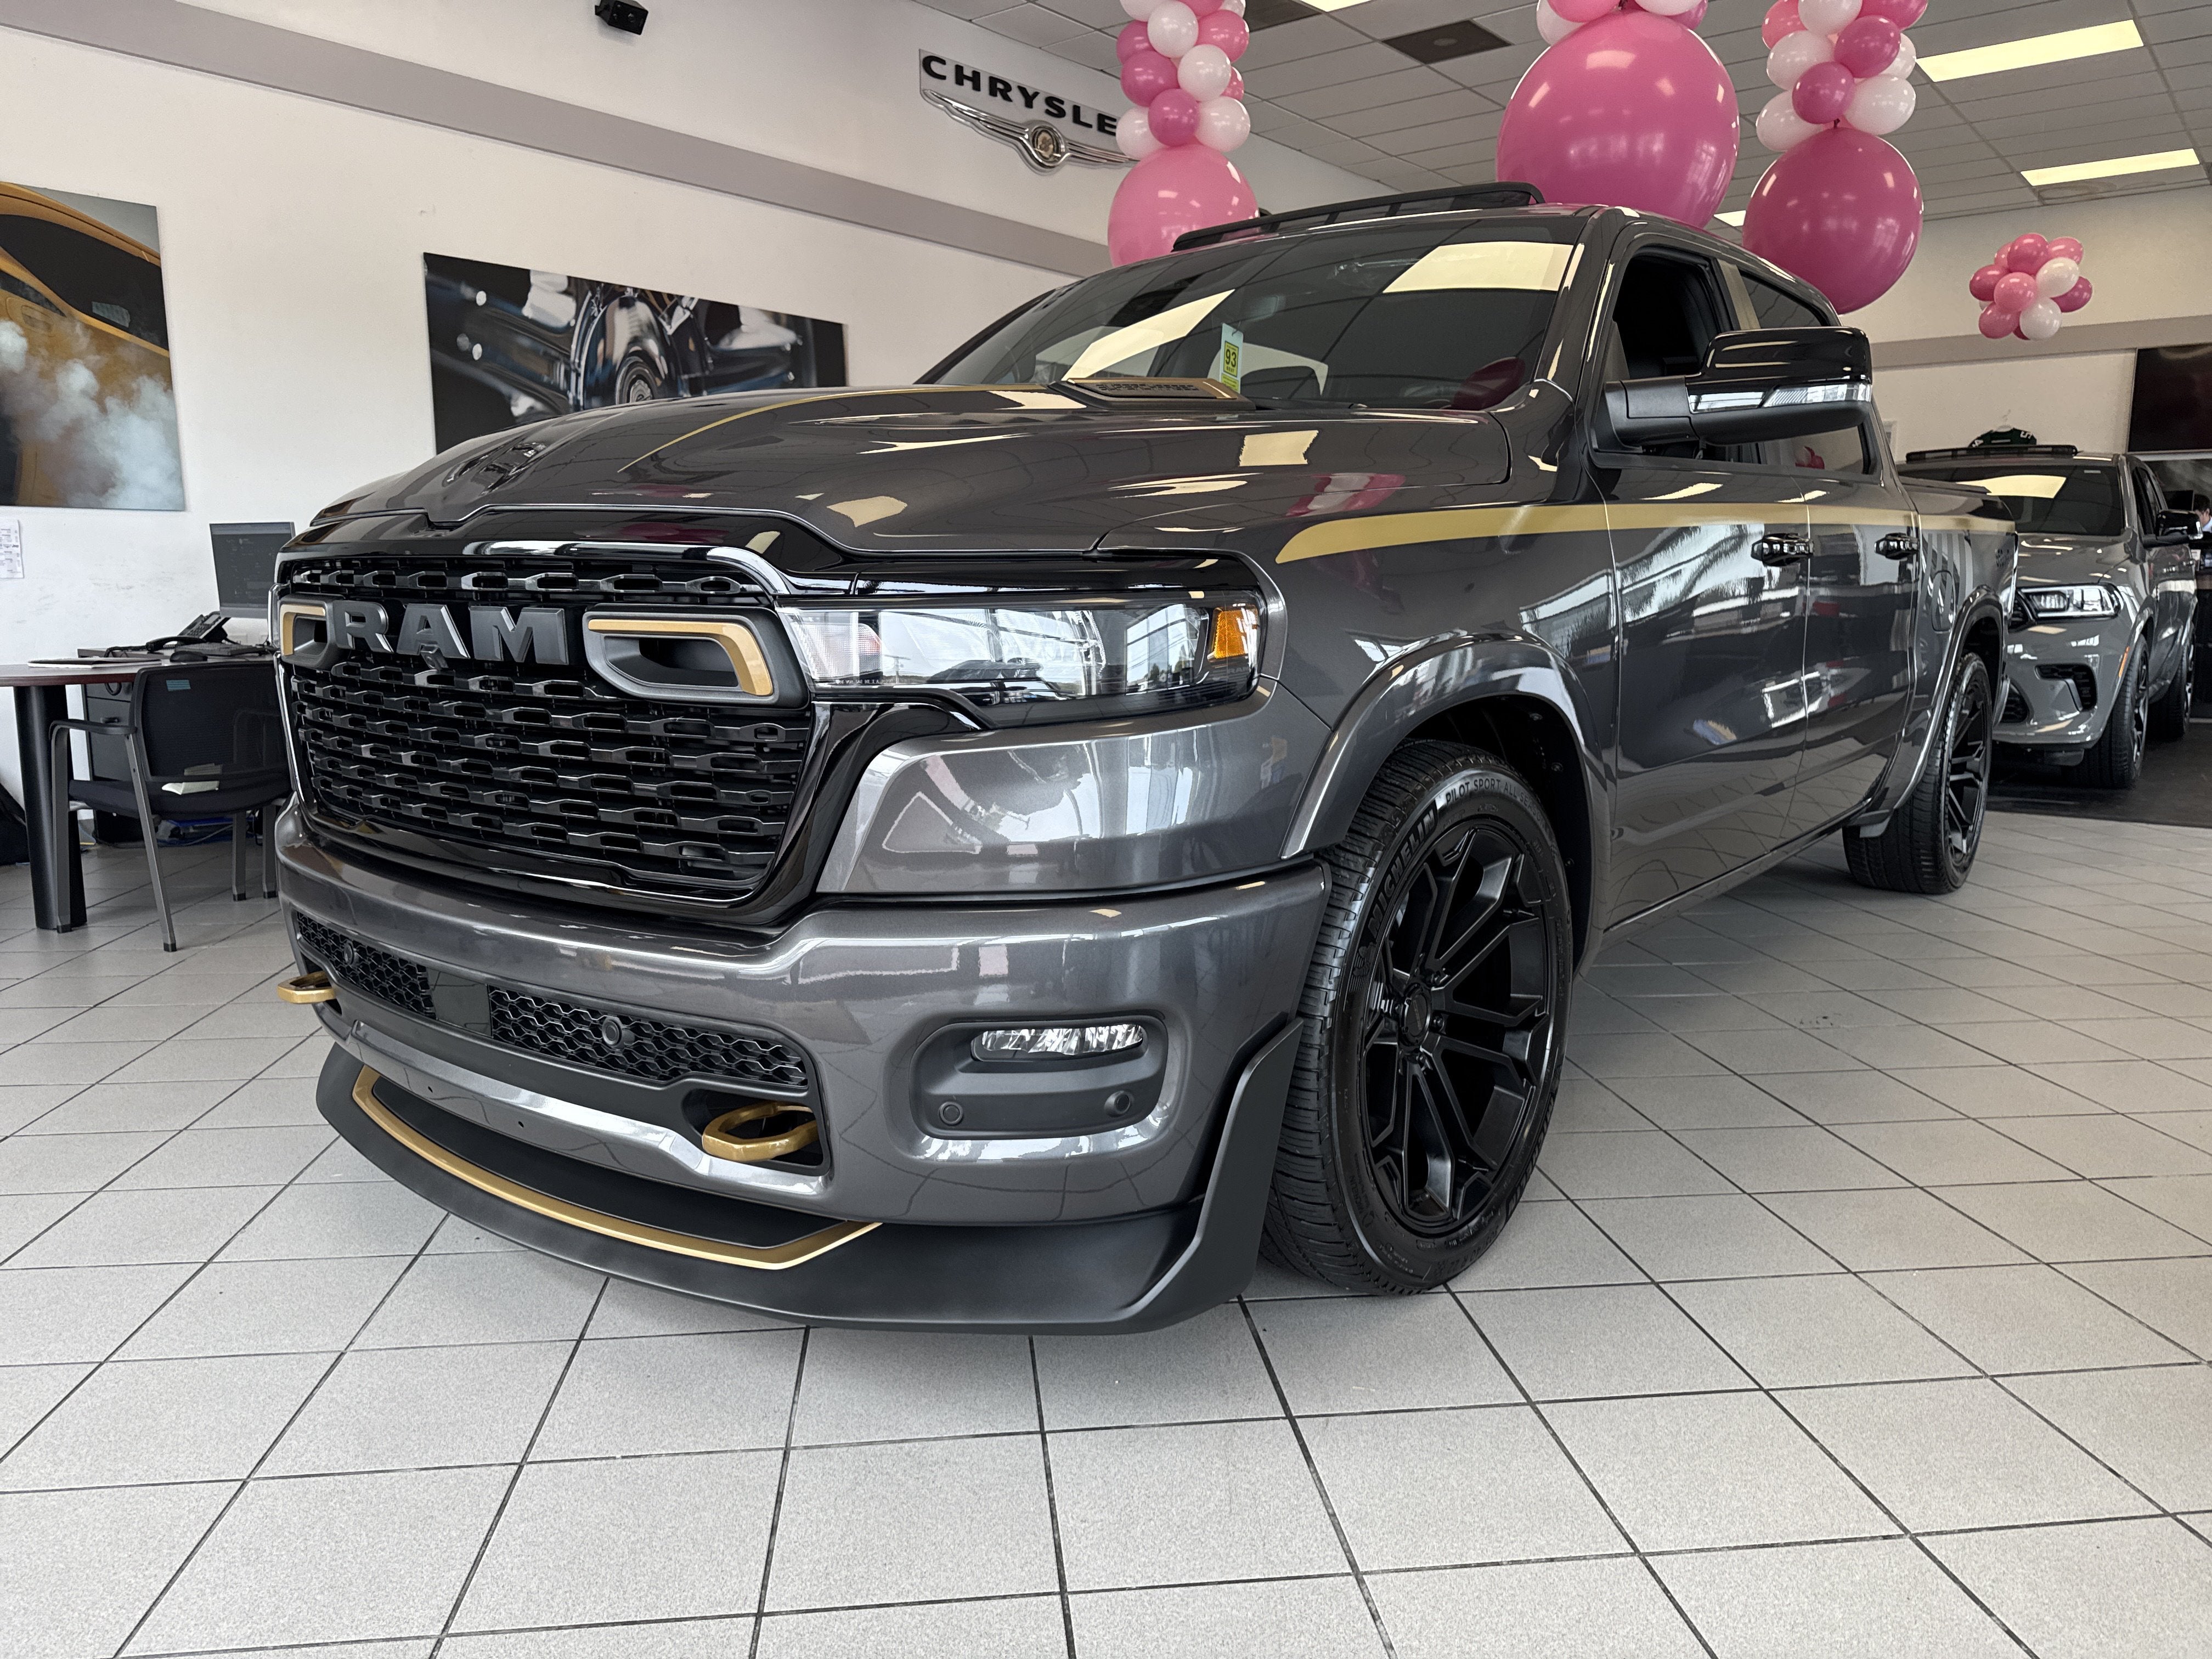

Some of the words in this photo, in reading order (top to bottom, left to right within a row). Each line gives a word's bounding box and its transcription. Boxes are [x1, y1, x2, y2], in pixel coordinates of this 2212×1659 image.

[922, 55, 1116, 136] CHRYSLE
[1226, 349, 1237, 367] 93
[332, 600, 569, 665] RAM
[1446, 782, 1470, 805] PILOT
[1474, 778, 1500, 791] SPORT
[1504, 782, 1517, 798] ALL
[1368, 809, 1436, 938] MICHELIN
